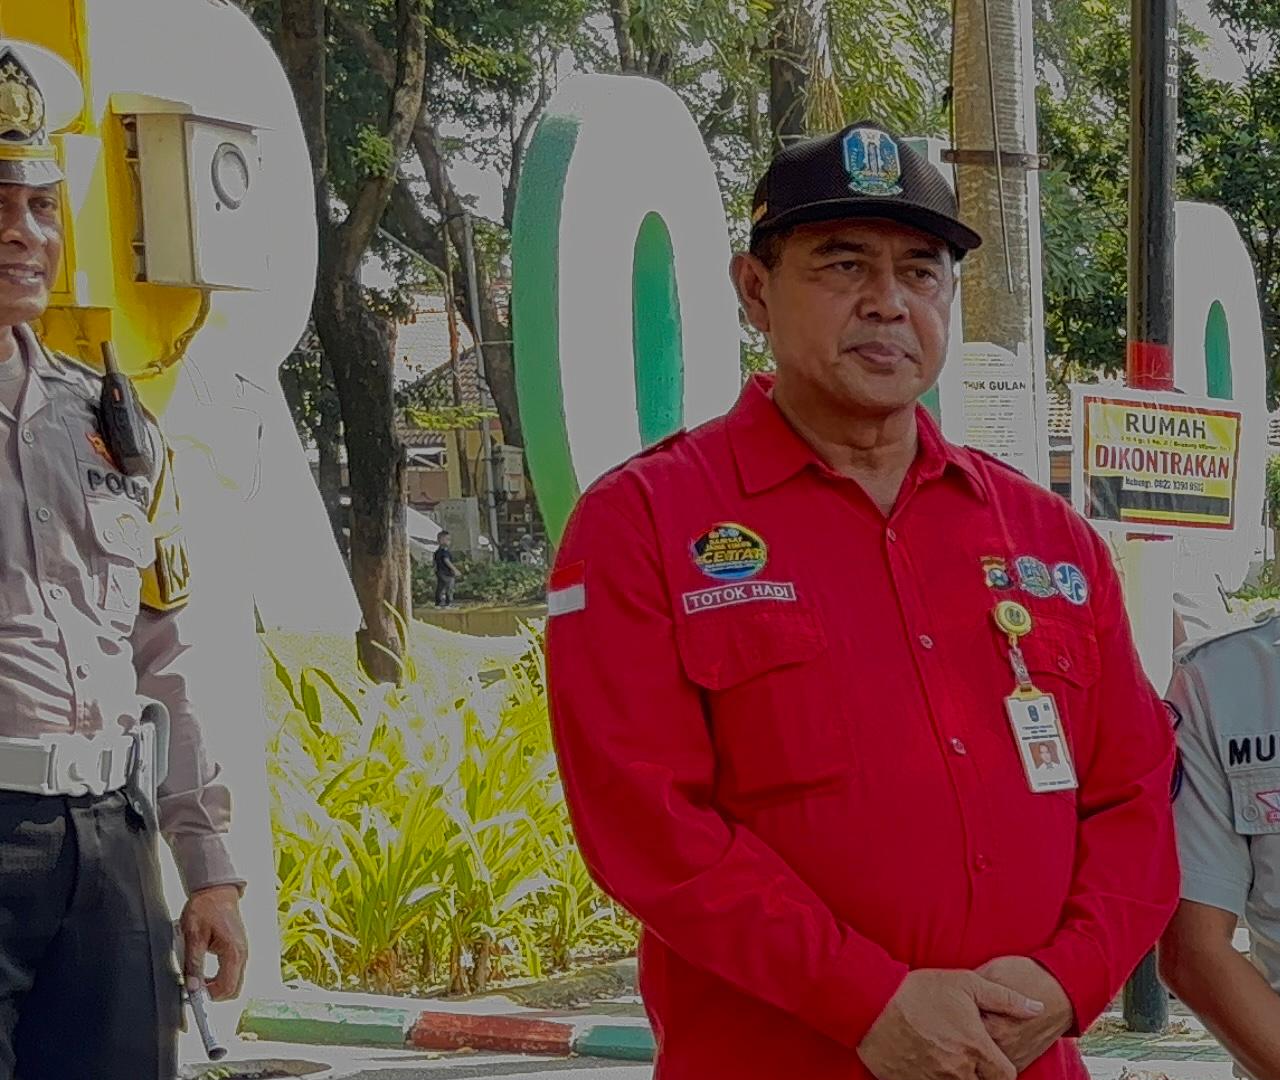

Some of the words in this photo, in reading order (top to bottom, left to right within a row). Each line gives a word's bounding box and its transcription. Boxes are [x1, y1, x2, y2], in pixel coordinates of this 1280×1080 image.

[1125, 412, 1207, 440] RUMAH
[1095, 444, 1230, 479] DIKONTRAKAN
[689, 586, 747, 608] TOTOK
[751, 584, 789, 598] HADI
